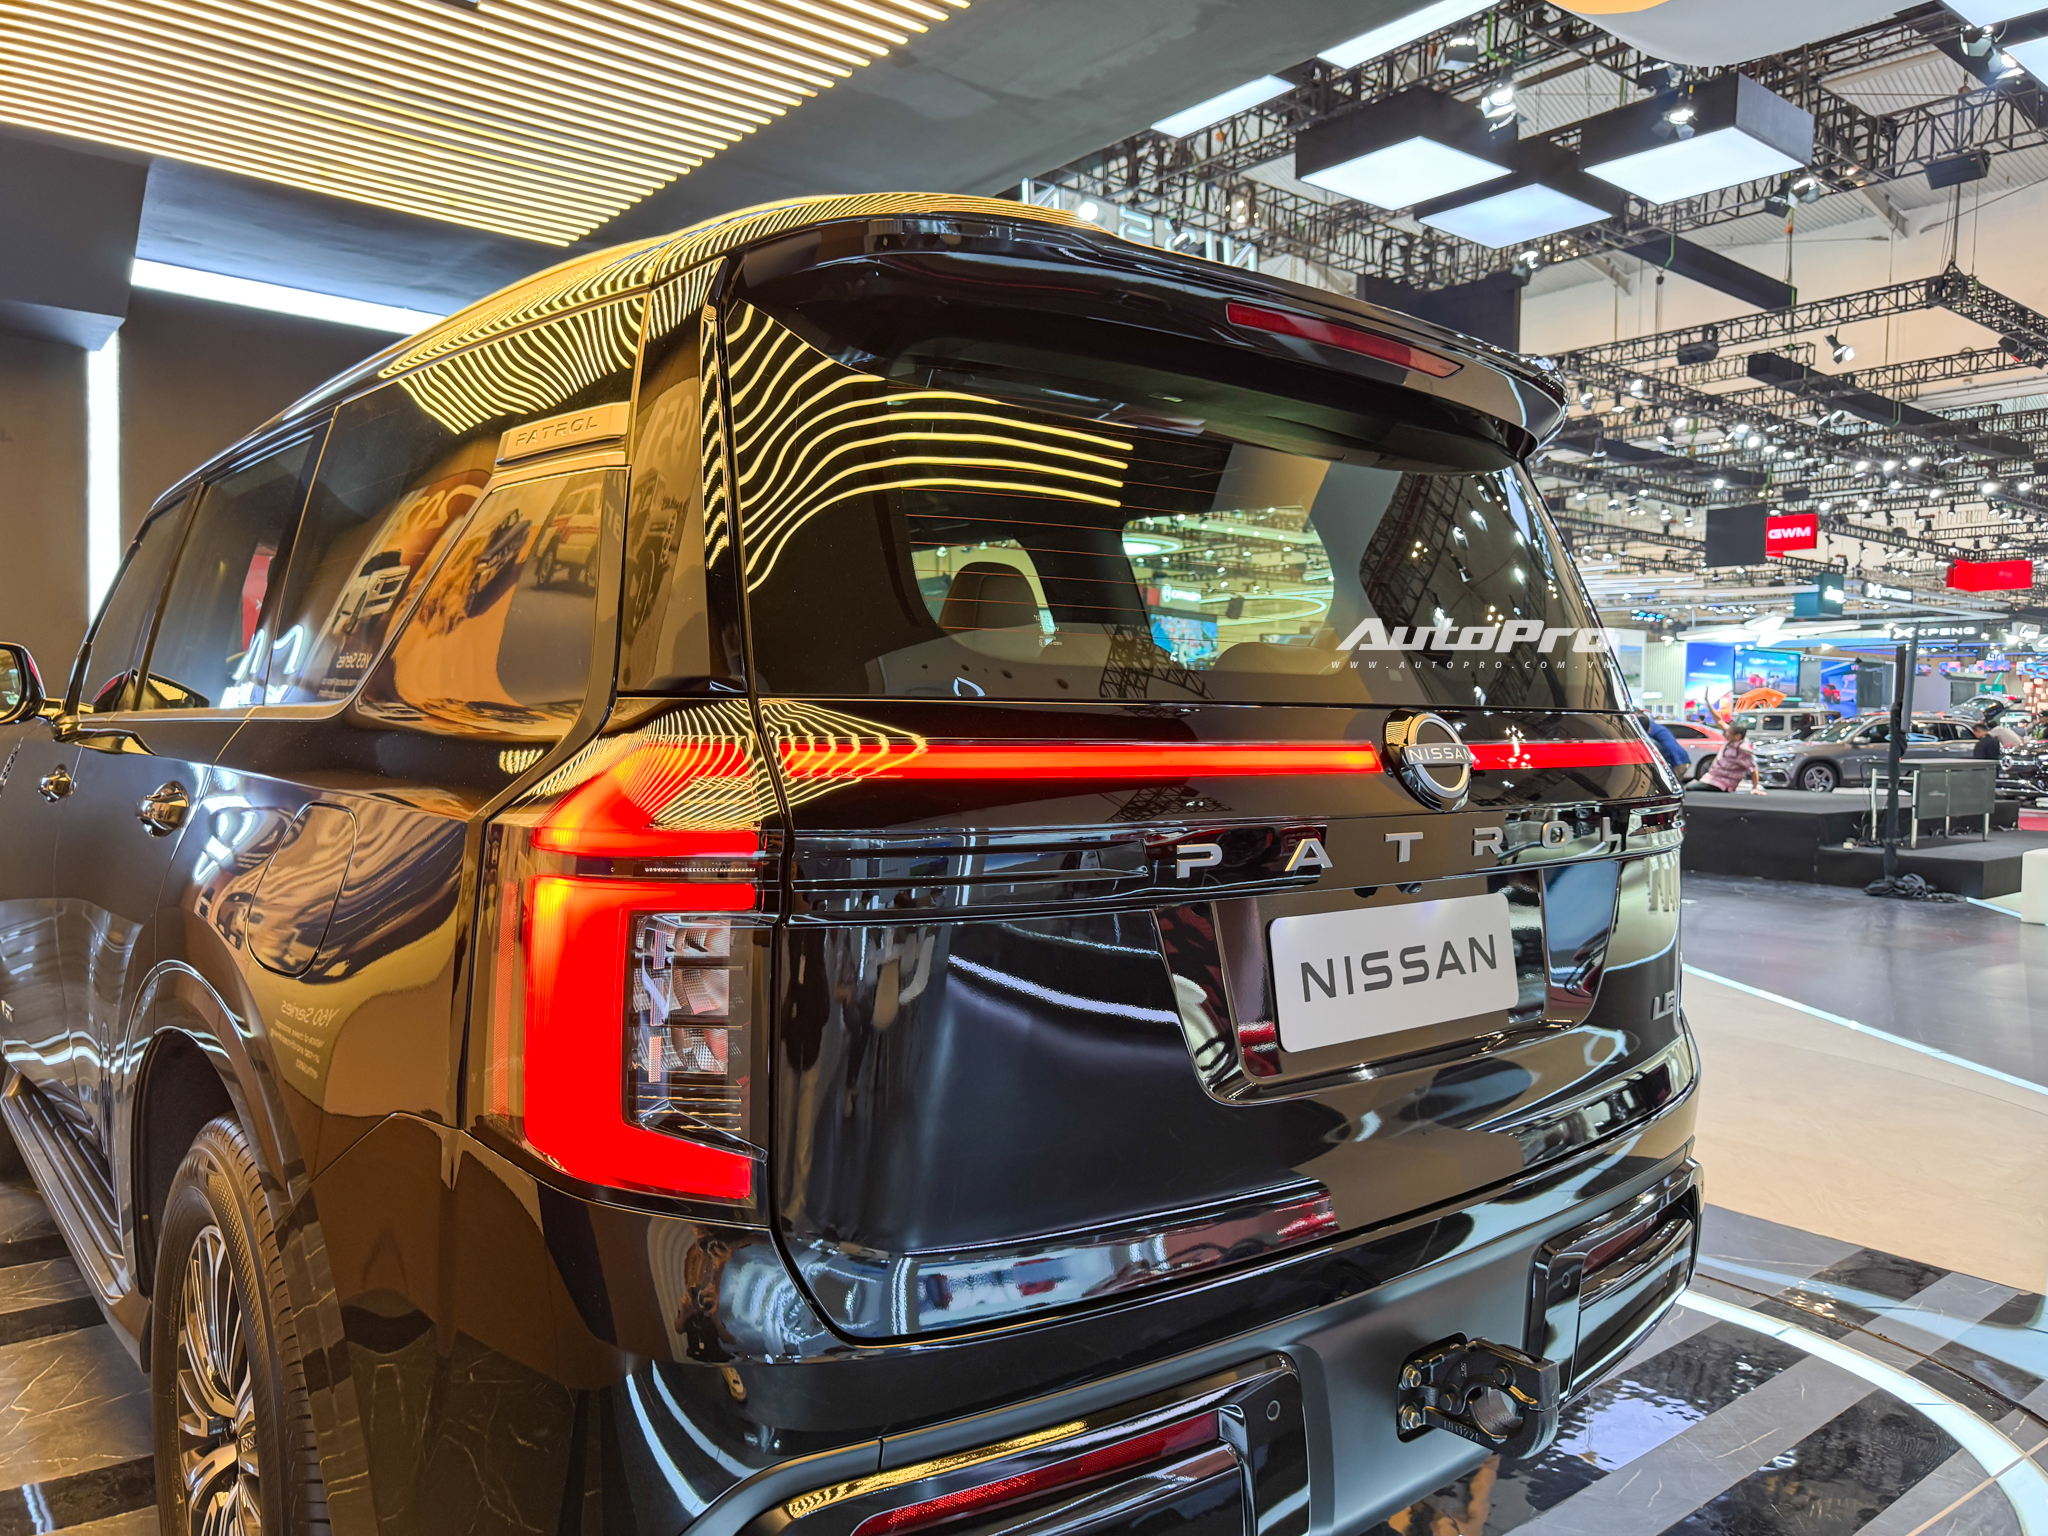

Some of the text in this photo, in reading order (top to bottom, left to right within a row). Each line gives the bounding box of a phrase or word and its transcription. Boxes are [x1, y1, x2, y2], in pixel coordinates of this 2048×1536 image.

[515, 416, 598, 447] PATROL
[1768, 526, 1811, 539] GWM
[1408, 746, 1472, 762] NISSAN
[1175, 816, 1622, 878] PATROL
[1301, 933, 1497, 1003] NISSAN
